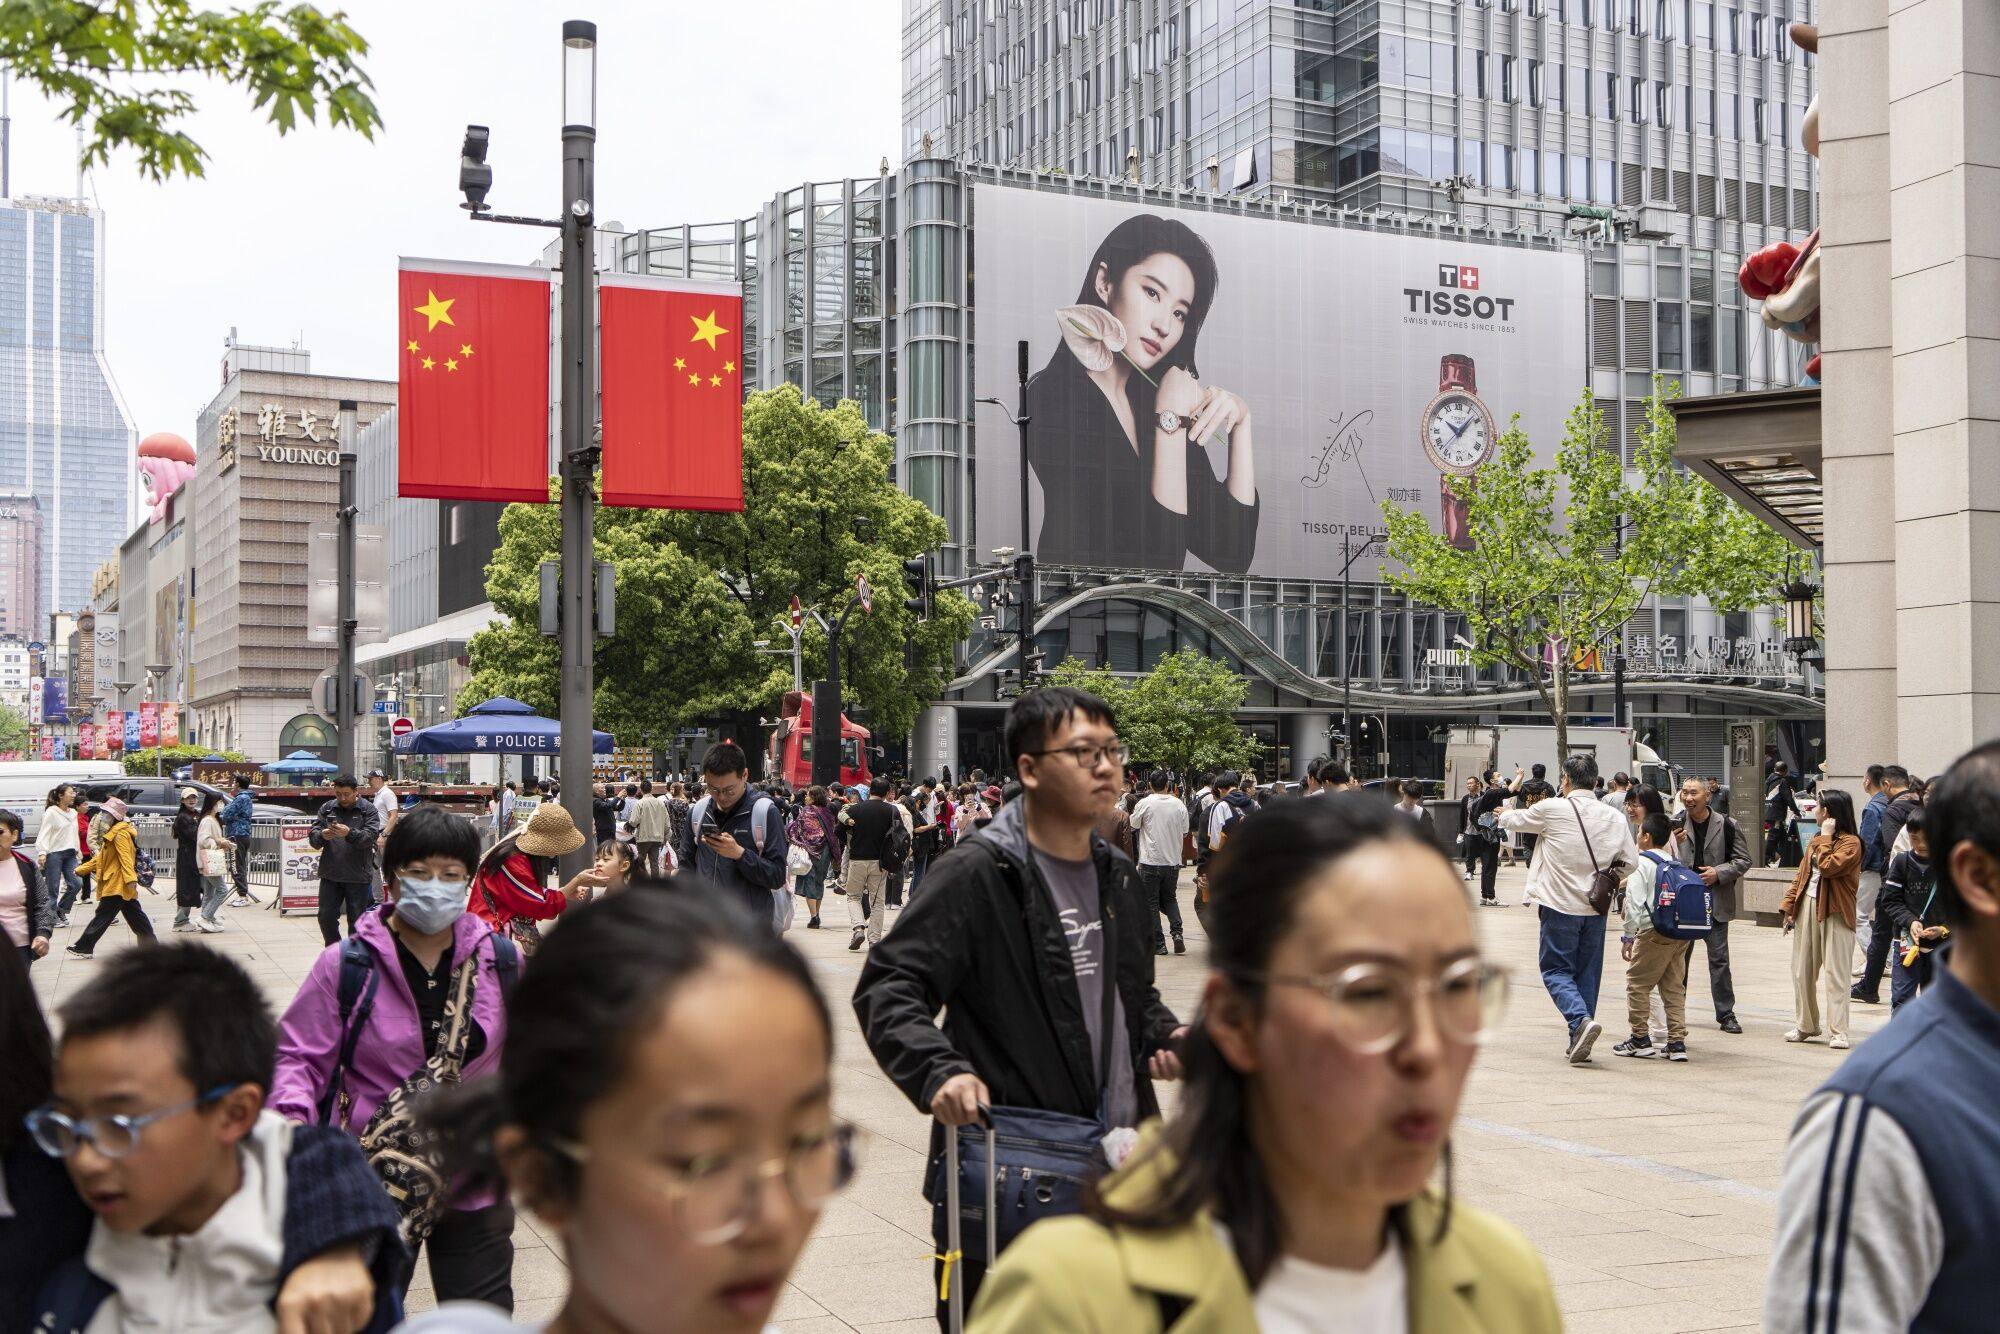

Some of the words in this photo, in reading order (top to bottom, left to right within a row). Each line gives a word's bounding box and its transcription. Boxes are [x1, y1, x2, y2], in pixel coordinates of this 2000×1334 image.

[1403, 288, 1515, 322] TISSOT
[1403, 317, 1428, 326] SWISS
[1432, 319, 1469, 329] WATCHES
[1471, 323, 1495, 332] SINCE
[1498, 326, 1516, 334] 1853
[257, 445, 340, 466] YOUNGO
[1386, 487, 1421, 502] 刘亦菲
[1302, 522, 1346, 535] TISSOT
[1338, 542, 1390, 558] 天梭小美
[495, 735, 546, 748] POLICE
